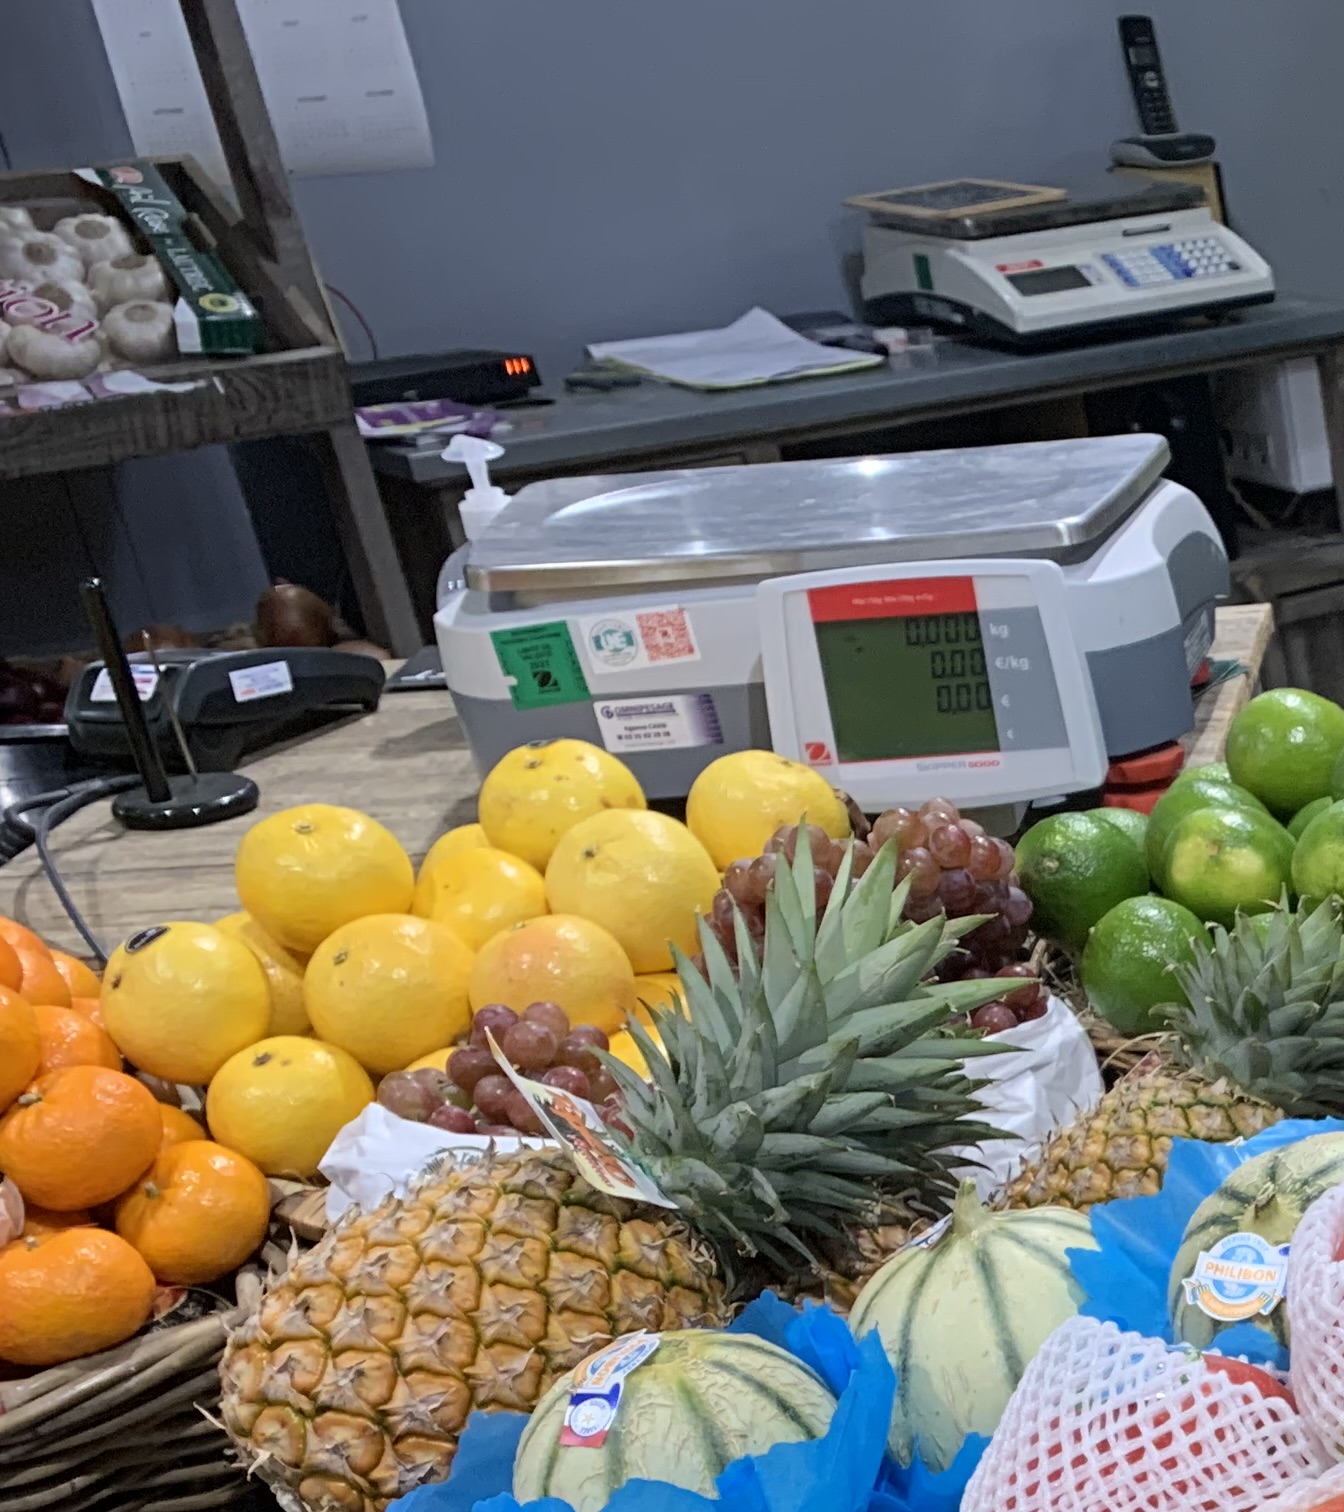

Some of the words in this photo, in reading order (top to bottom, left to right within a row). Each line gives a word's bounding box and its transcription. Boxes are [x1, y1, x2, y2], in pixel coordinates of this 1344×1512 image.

[989, 622, 1009, 639] kg
[994, 654, 1030, 672] €/kg
[1204, 1261, 1278, 1282] PHILIBON
